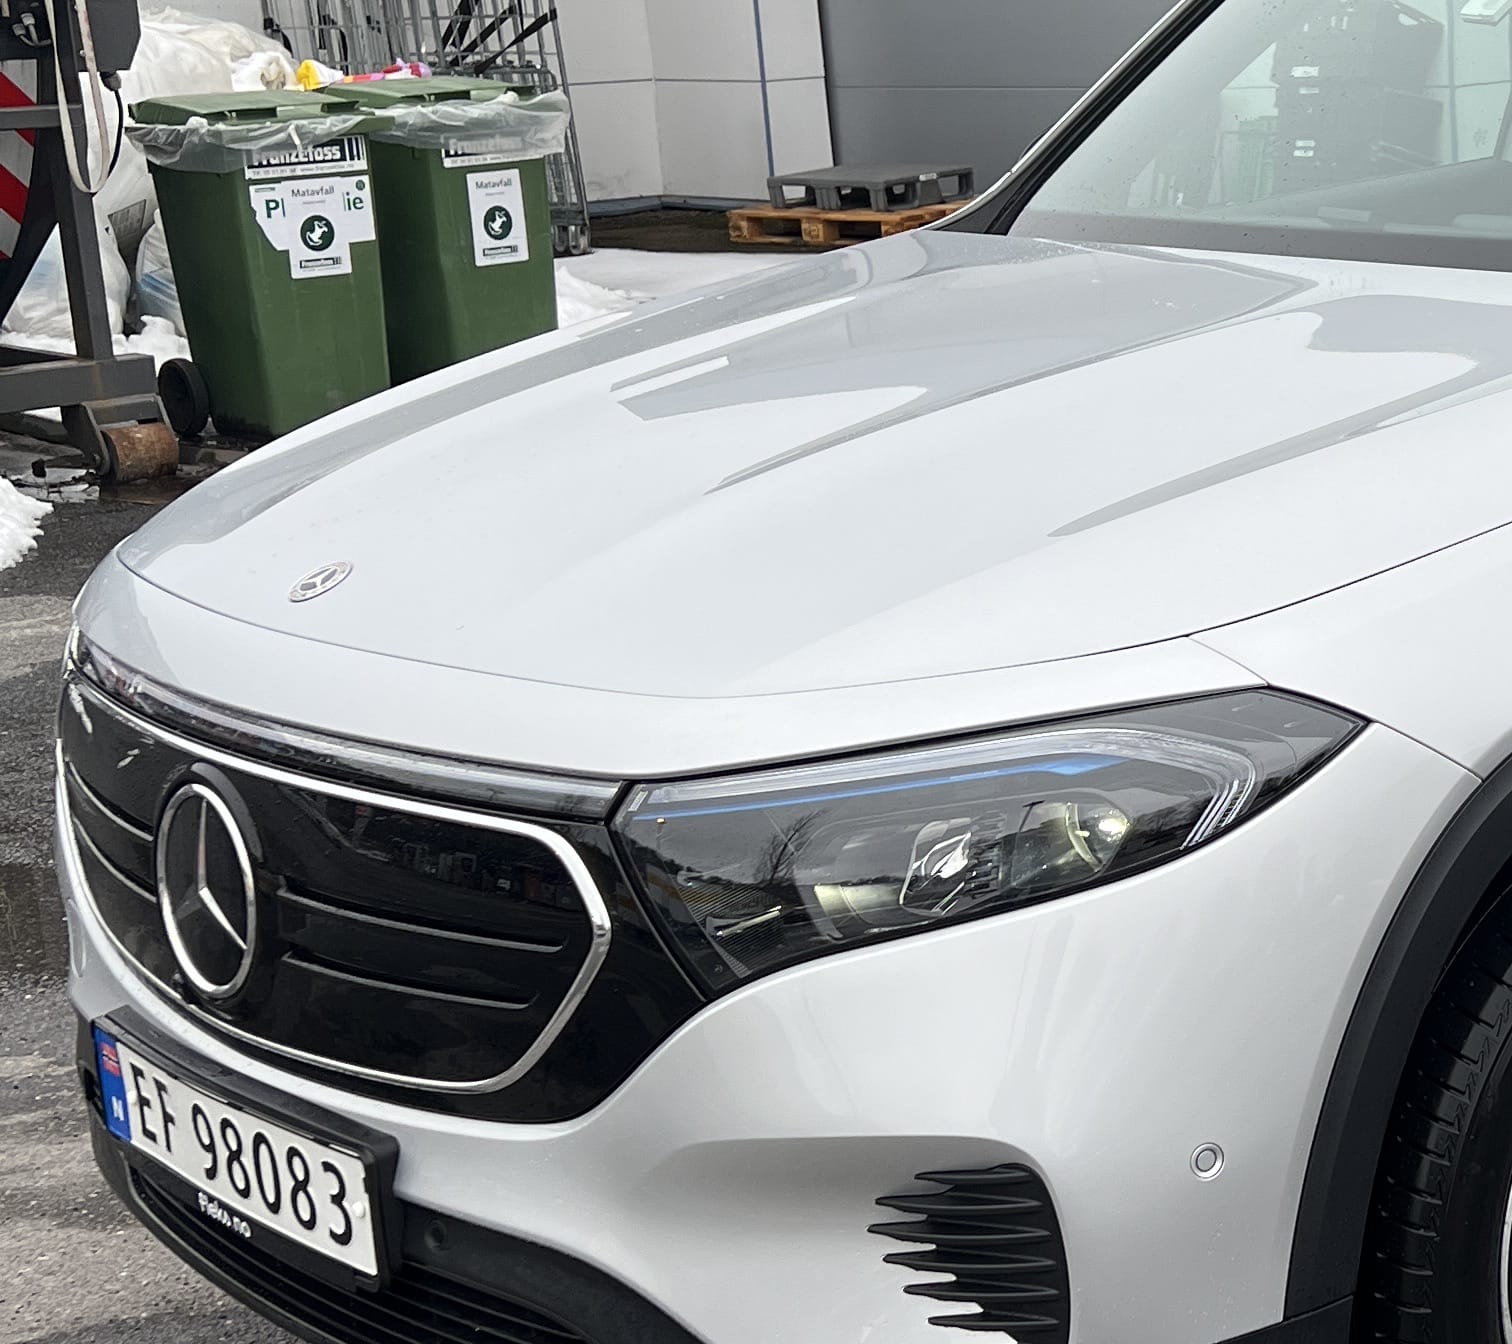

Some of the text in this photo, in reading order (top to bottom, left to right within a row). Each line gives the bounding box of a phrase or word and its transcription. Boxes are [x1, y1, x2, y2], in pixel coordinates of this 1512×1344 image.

[475, 178, 512, 189] Matavfall
[291, 186, 335, 198] Matavfall
[131, 1062, 176, 1152] EF
[191, 1103, 352, 1246] 98083
